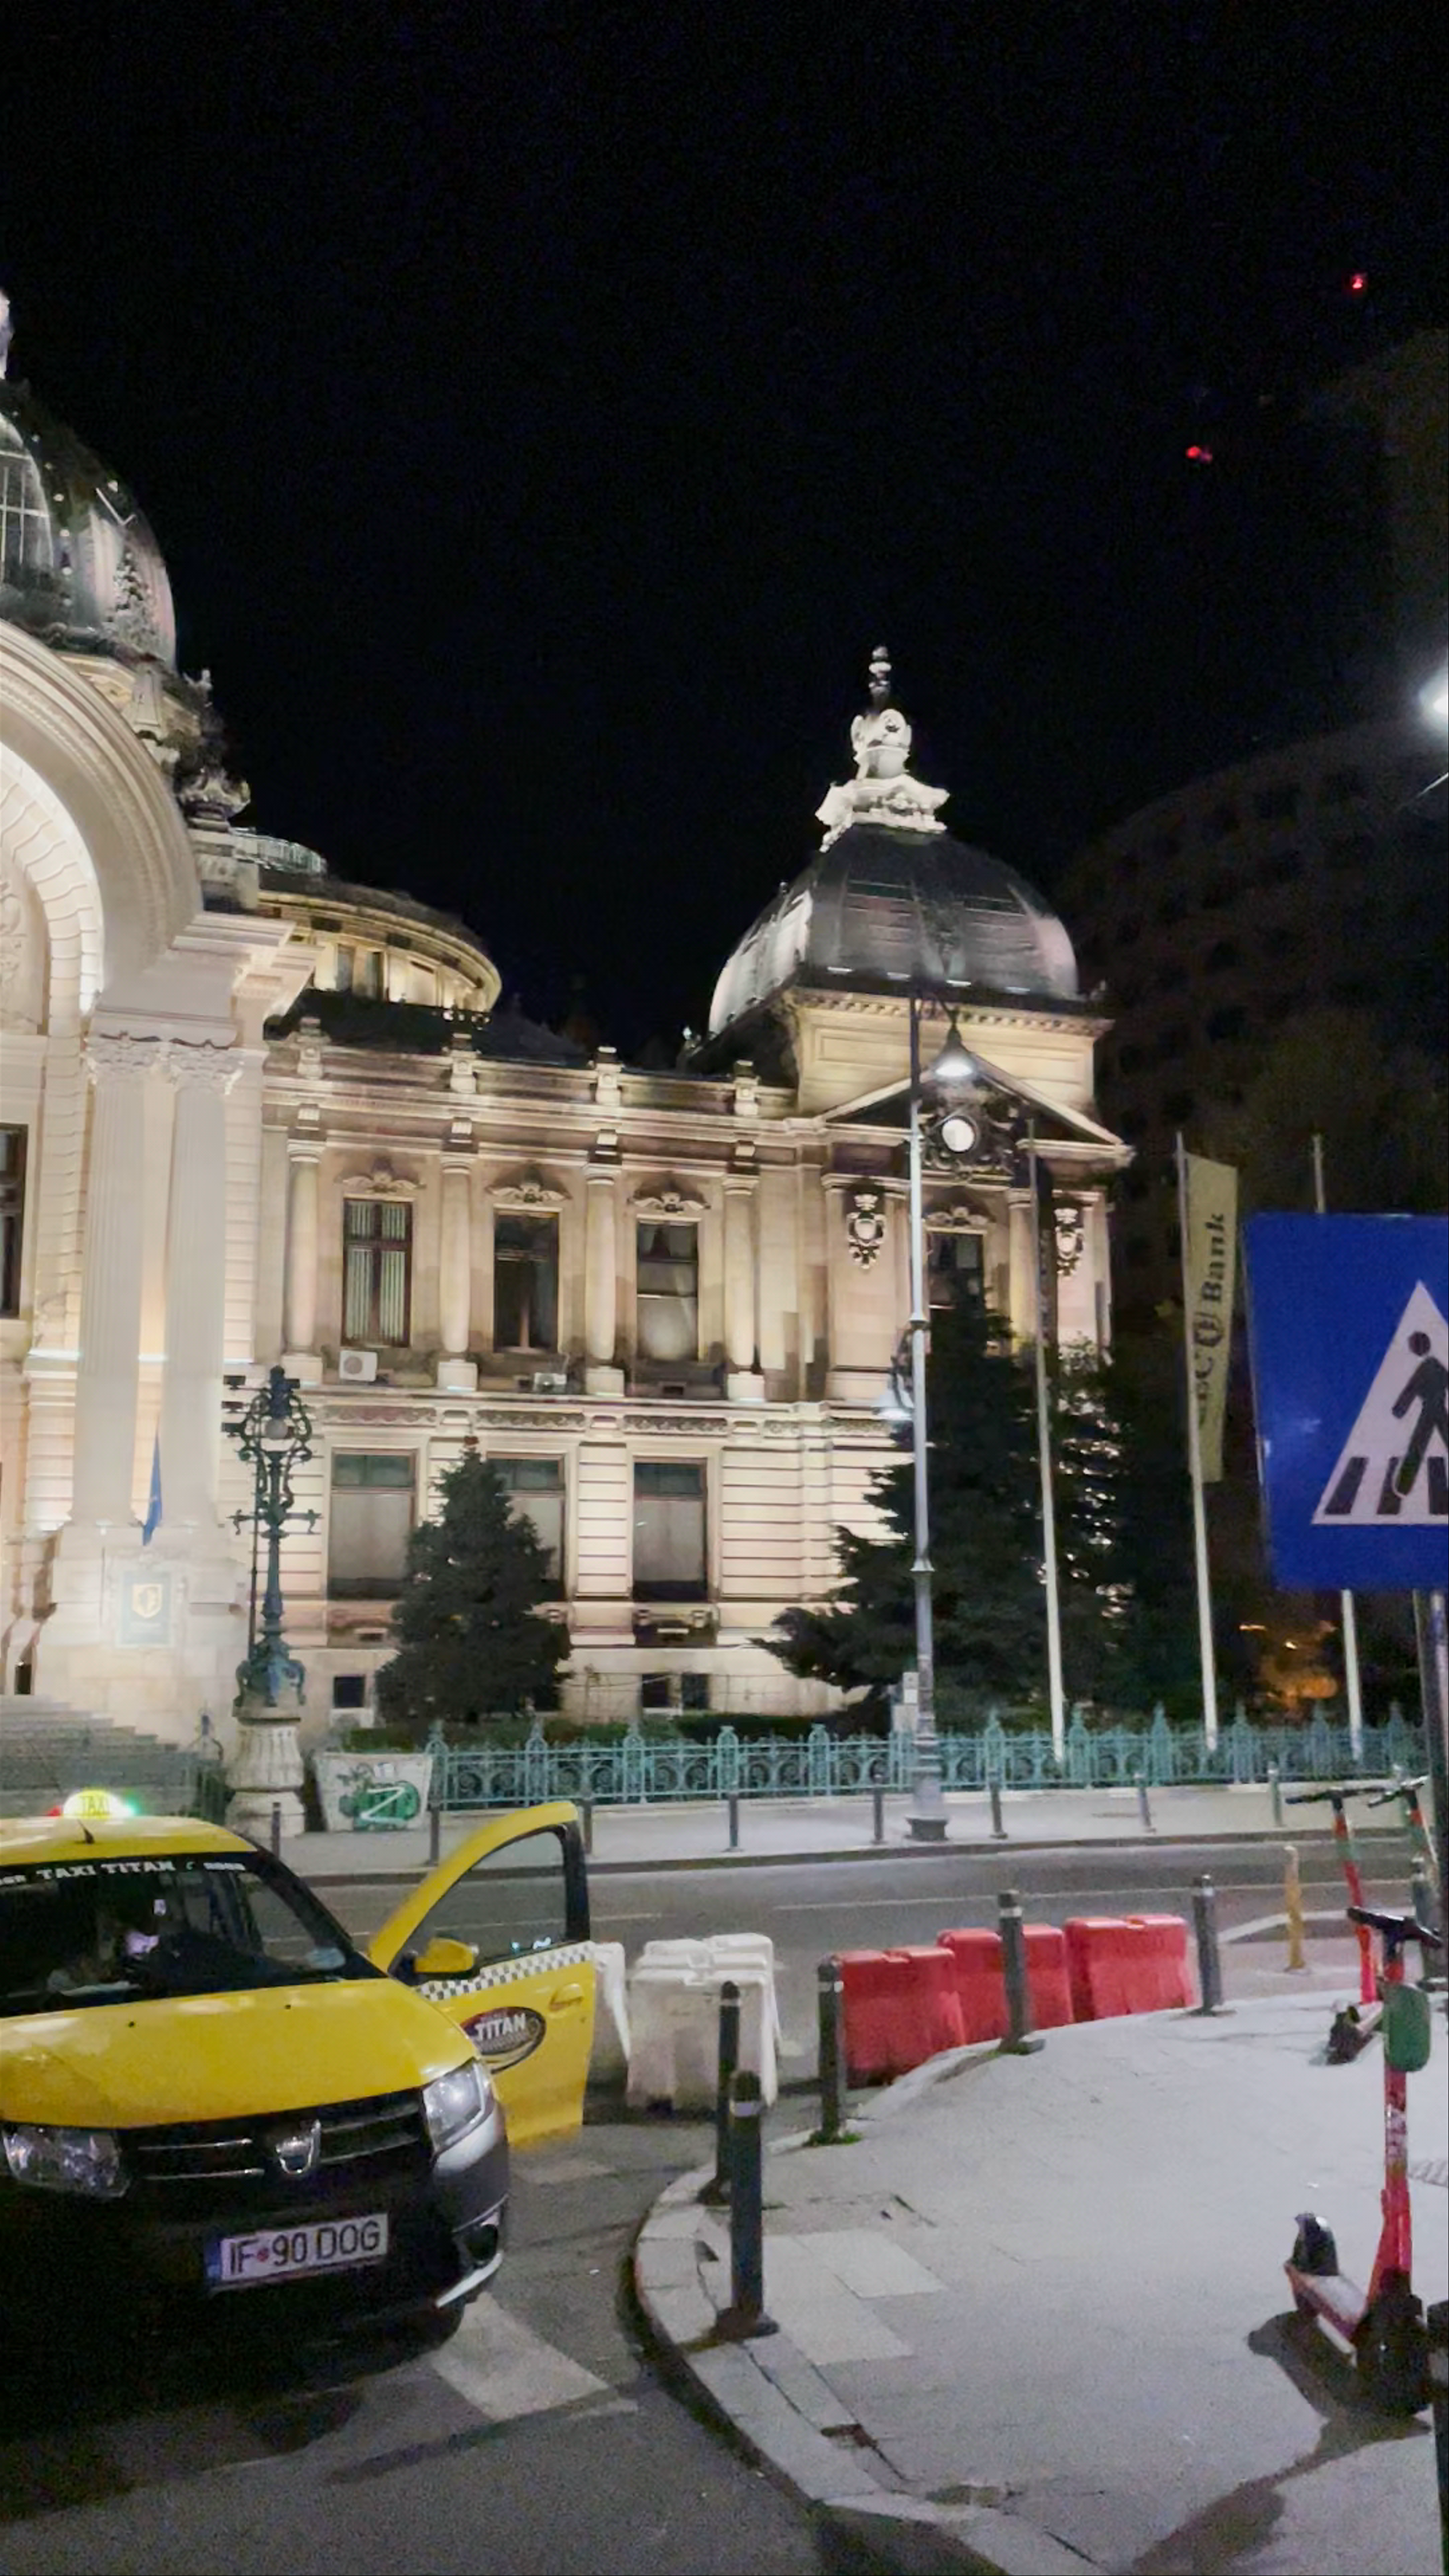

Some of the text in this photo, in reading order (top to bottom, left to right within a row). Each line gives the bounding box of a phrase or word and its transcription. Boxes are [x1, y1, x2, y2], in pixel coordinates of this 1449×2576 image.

[1202, 1213, 1225, 1302] Bank
[80, 1795, 109, 1814] TAXI
[36, 1861, 176, 1879] TAXI TITAN
[474, 2013, 526, 2041] TITAN
[230, 2221, 381, 2275] IF 90 DOG
